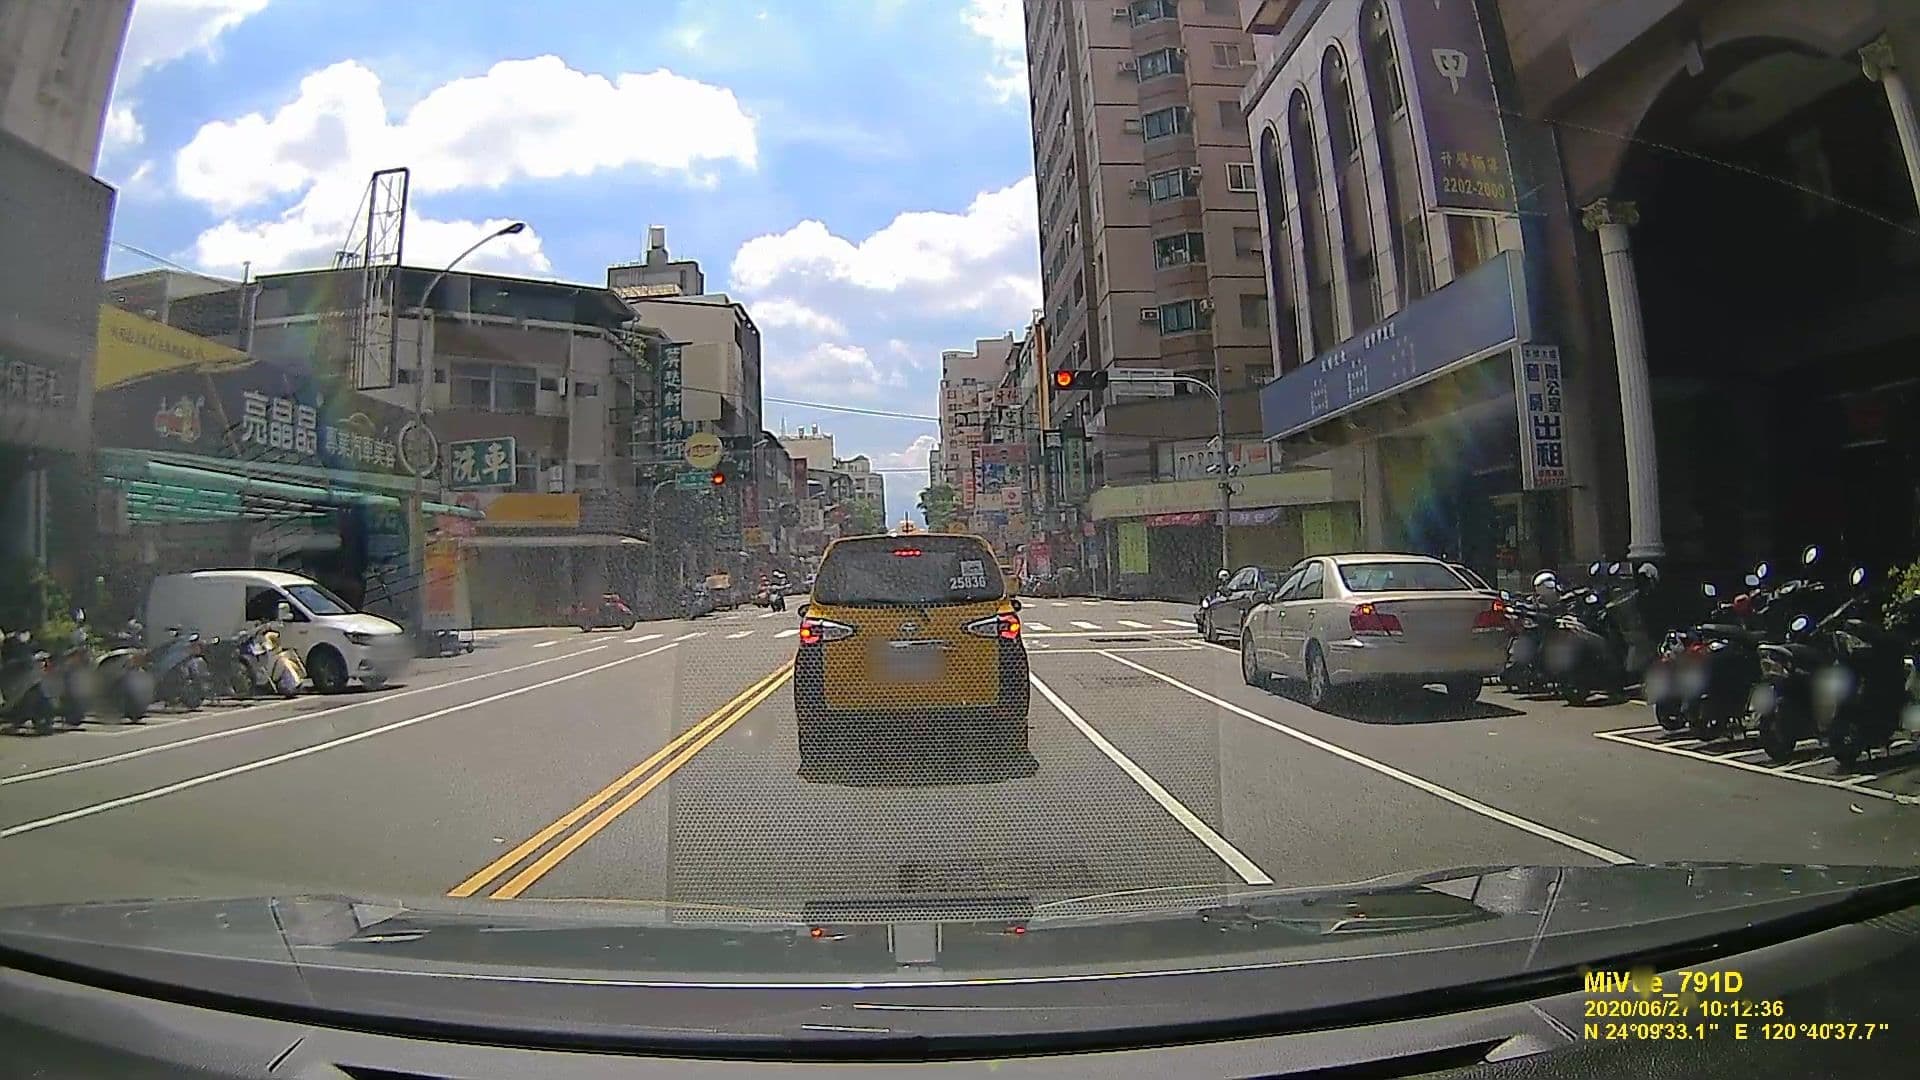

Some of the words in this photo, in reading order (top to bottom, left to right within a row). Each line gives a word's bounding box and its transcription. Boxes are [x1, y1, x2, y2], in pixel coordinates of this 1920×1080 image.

[242, 390, 317, 455] 亮晶晶
[1534, 415, 1564, 467] 出租
[453, 442, 509, 482] 洗車
